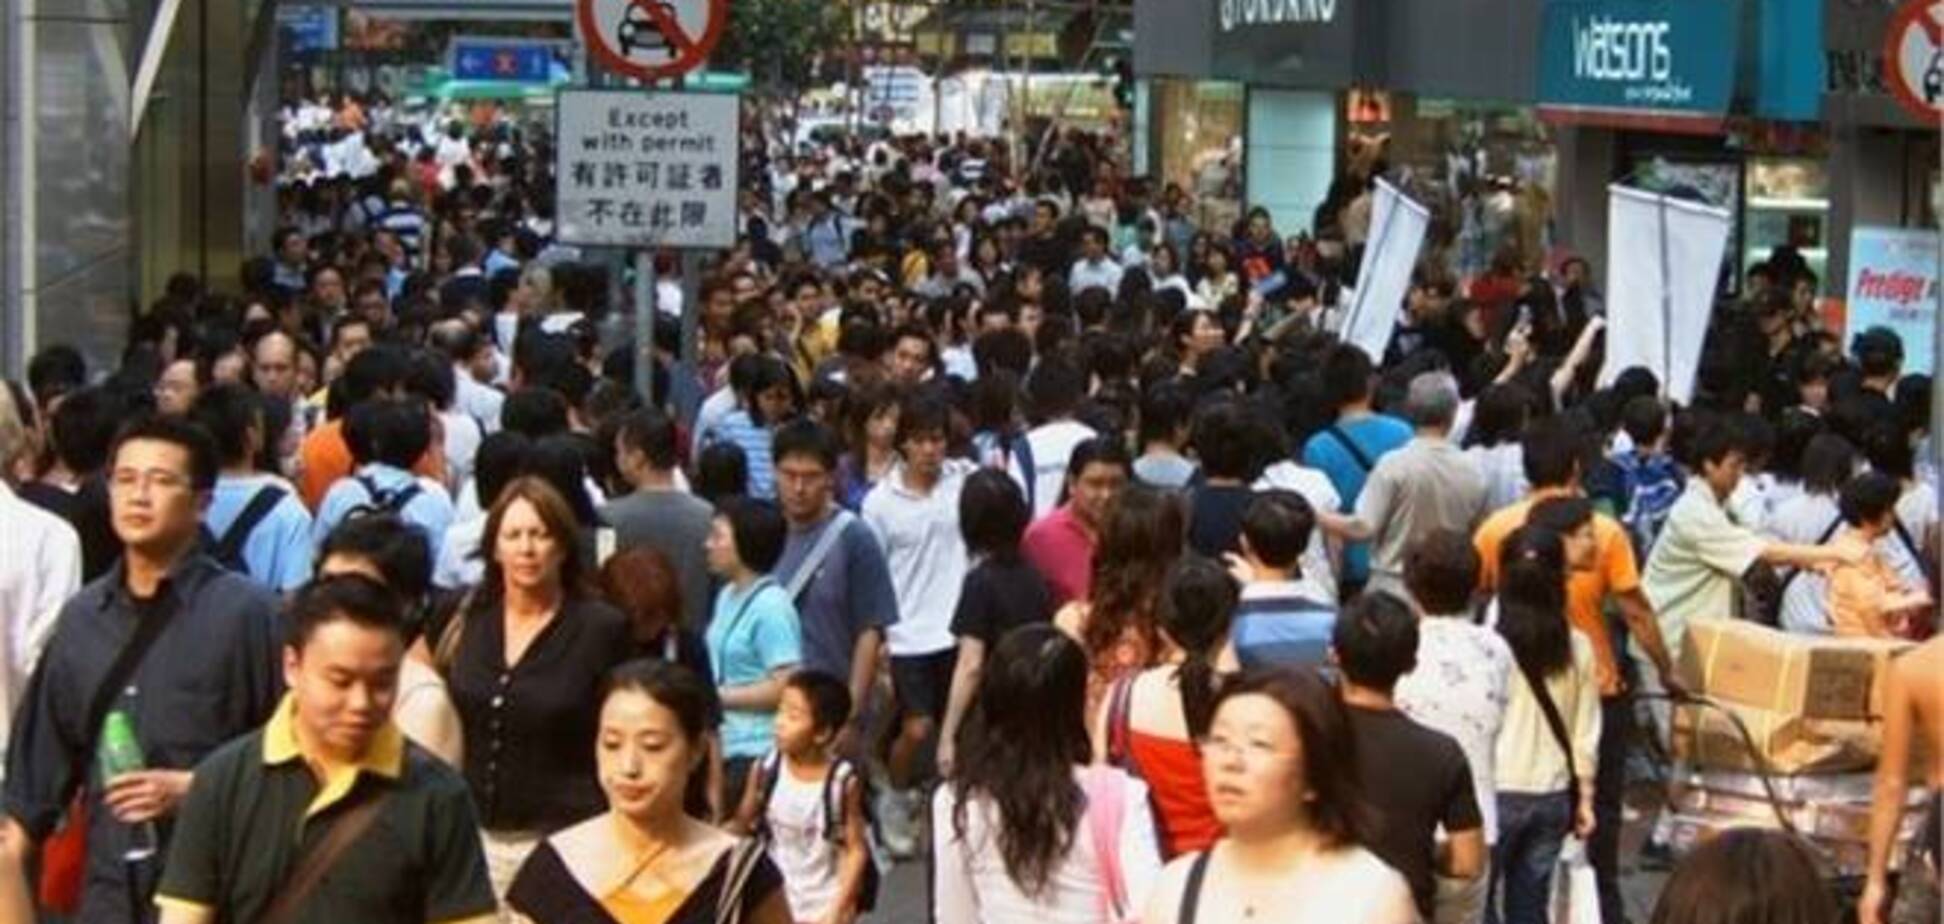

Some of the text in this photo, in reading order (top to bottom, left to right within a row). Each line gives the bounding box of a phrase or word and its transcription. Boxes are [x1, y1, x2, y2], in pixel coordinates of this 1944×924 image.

[608, 106, 689, 129] Except
[582, 131, 715, 153] with permit
[586, 199, 708, 228] 不在此限
